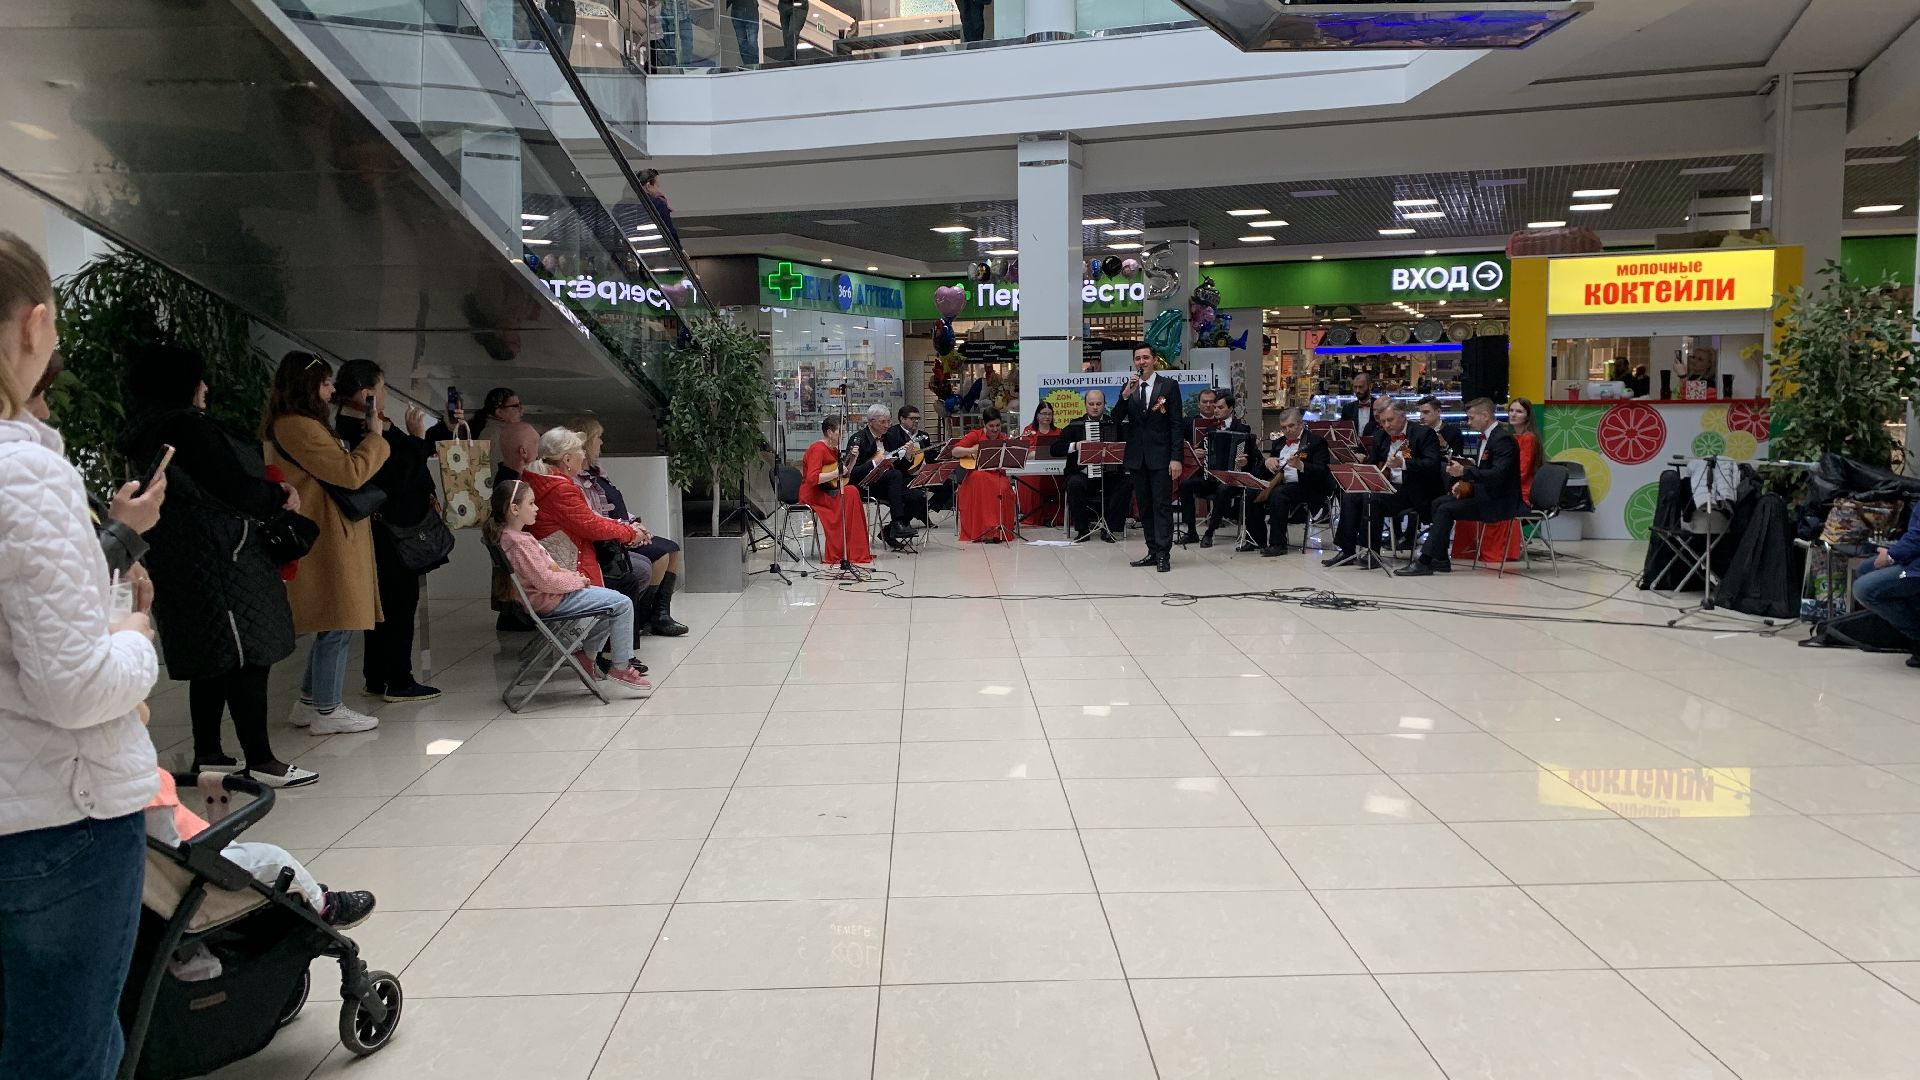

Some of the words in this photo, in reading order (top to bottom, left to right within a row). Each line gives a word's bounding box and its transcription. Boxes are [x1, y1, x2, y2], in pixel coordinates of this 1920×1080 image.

[1392, 266, 1470, 292] ВХОД
[1043, 377, 1113, 386] КОМФОРТНЫЕ
[1115, 376, 1131, 385] ДО
